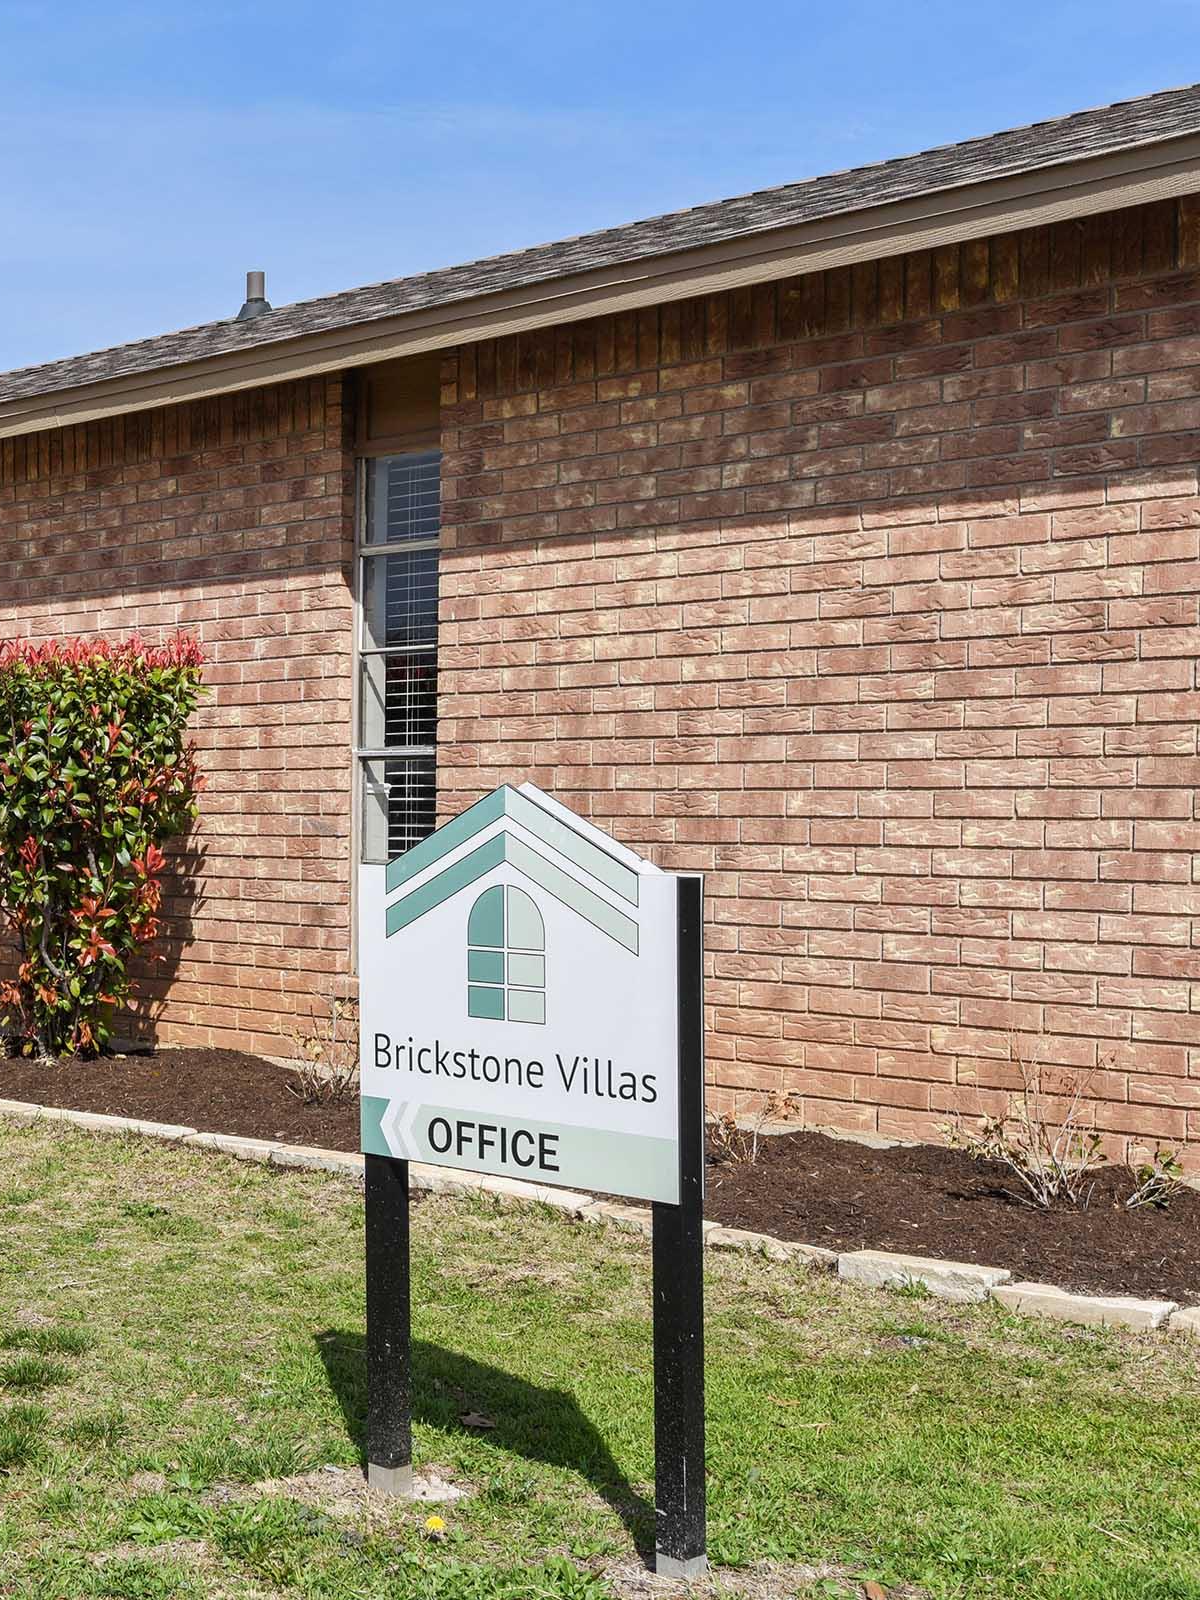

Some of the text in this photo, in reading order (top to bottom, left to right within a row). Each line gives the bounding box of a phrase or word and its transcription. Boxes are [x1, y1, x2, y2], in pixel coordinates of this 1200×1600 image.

[374, 1032, 658, 1104] Brickstone Villas
[427, 1116, 560, 1173] OFFICE
